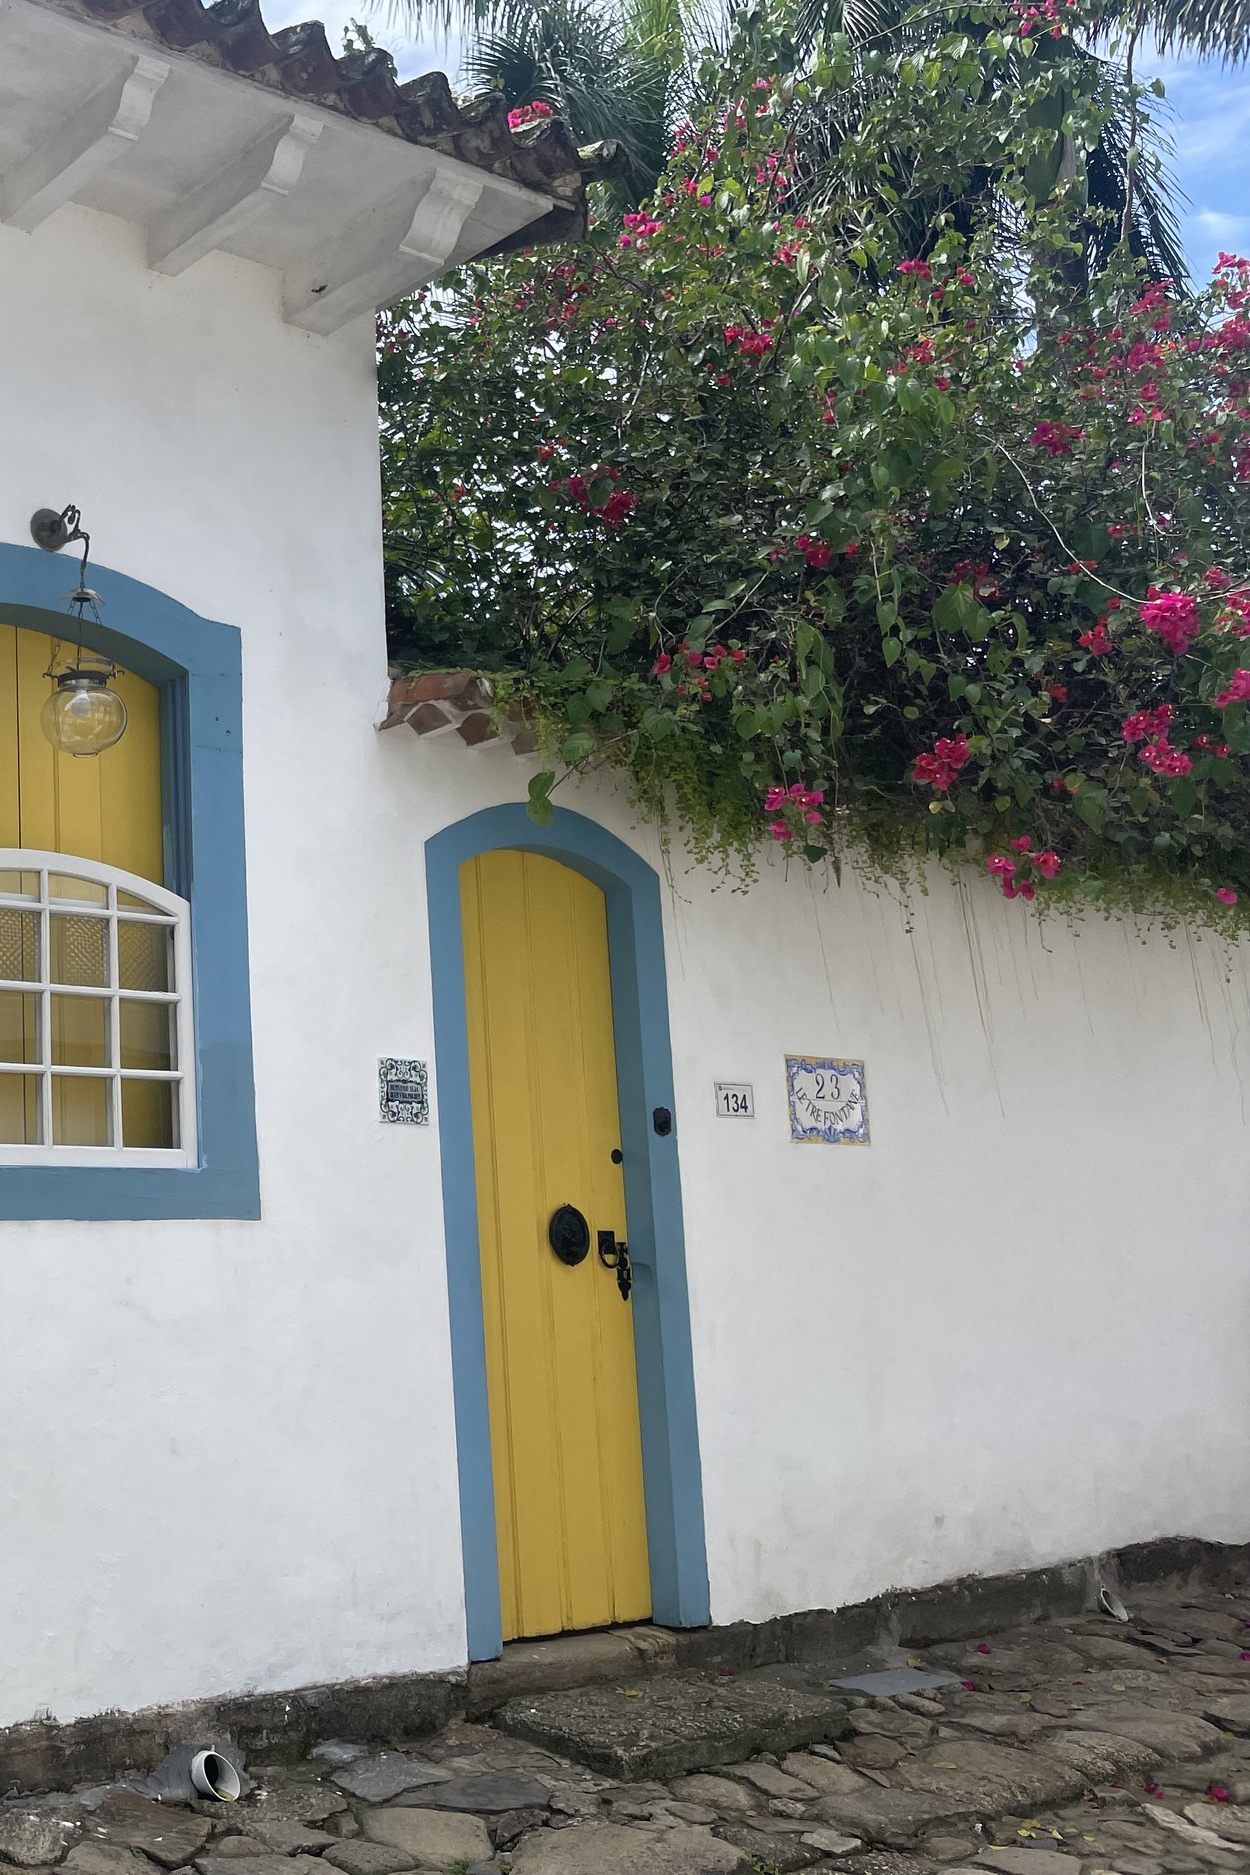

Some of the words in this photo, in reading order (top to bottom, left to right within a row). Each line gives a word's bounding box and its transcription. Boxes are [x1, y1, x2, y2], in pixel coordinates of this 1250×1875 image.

[815, 1073, 840, 1100] 23
[724, 1093, 748, 1113] 134
[796, 1086, 808, 1105] LE
[805, 1098, 823, 1124] TRE
